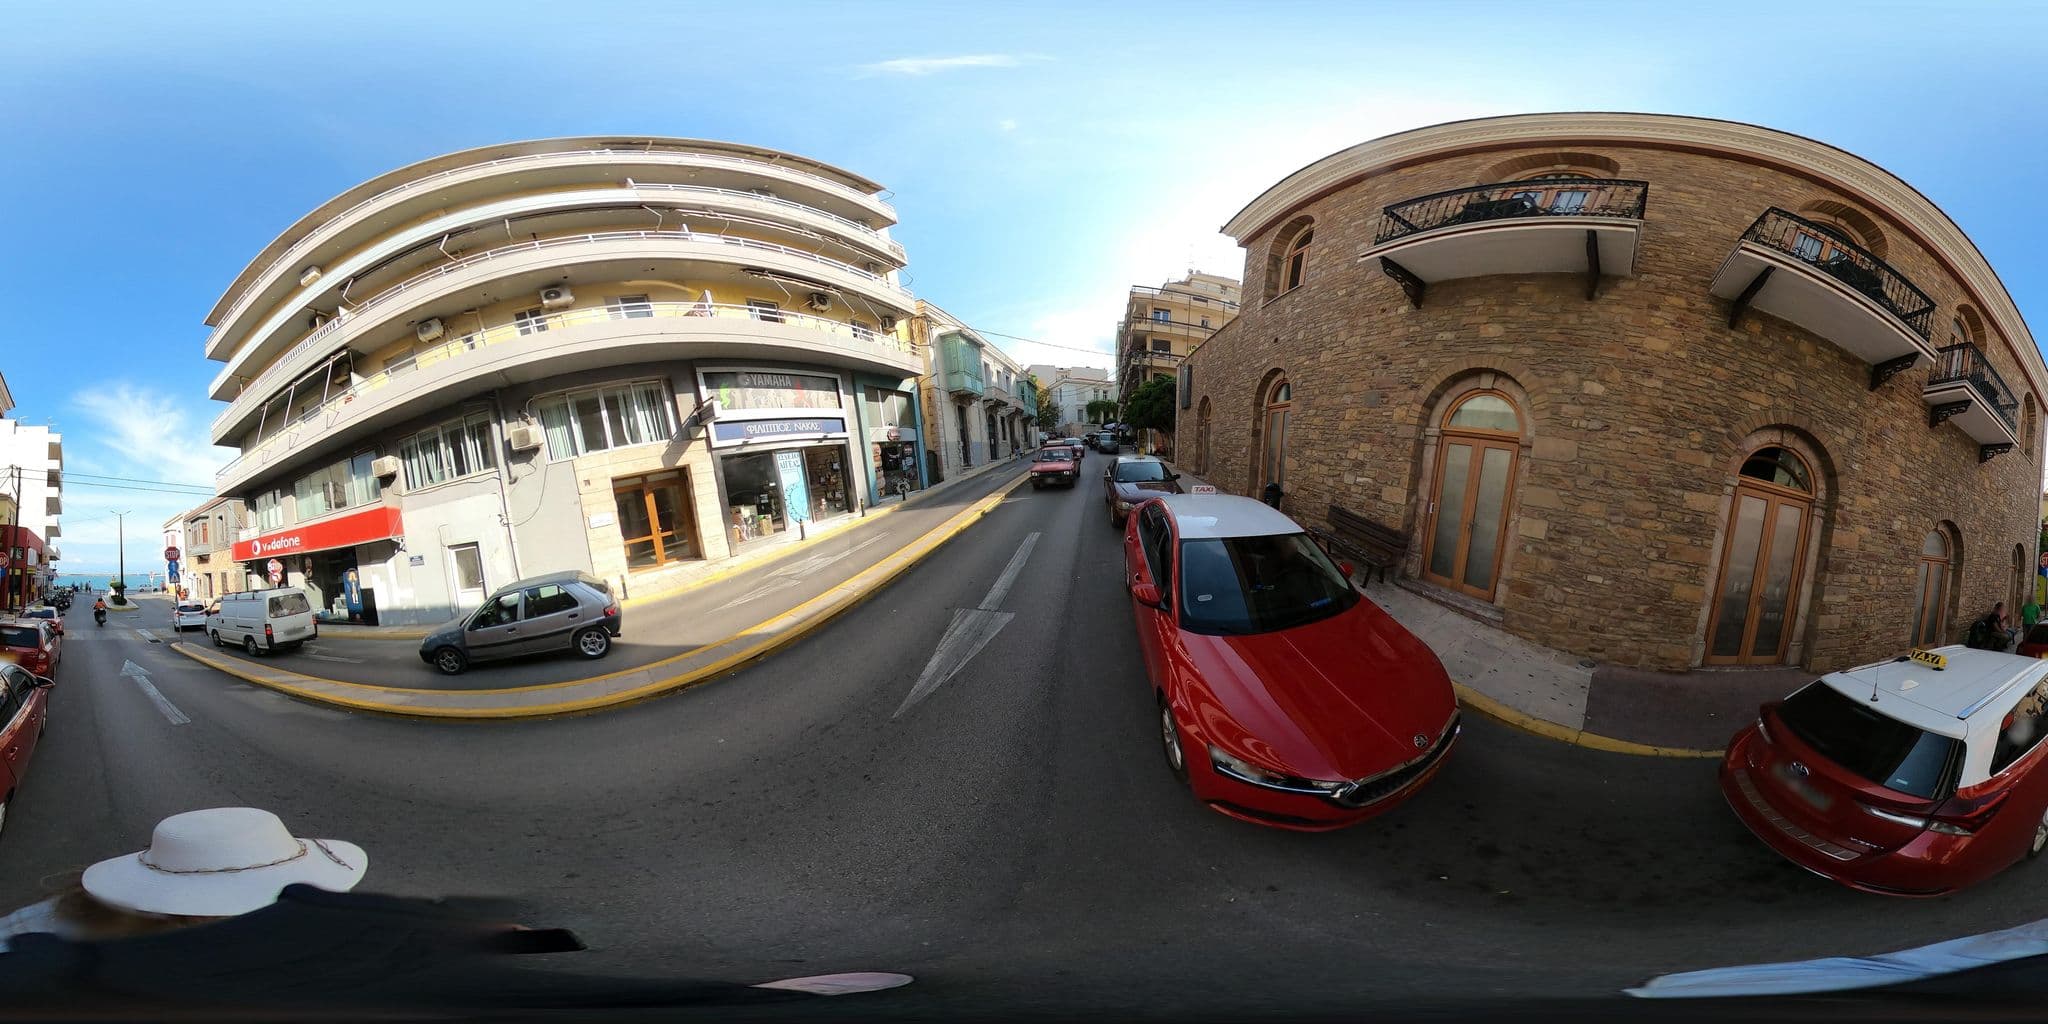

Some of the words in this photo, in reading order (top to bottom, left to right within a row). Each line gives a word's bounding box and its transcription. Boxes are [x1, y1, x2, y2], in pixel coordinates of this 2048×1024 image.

[750, 374, 791, 386] YAMAHA
[746, 423, 791, 434] ΦΙΛΙΠΠΟΣ
[795, 421, 821, 432] ΝΑΚΑΣ
[262, 536, 300, 551] vodafone
[166, 550, 179, 559] STOP
[1912, 650, 1941, 665] TAXI
